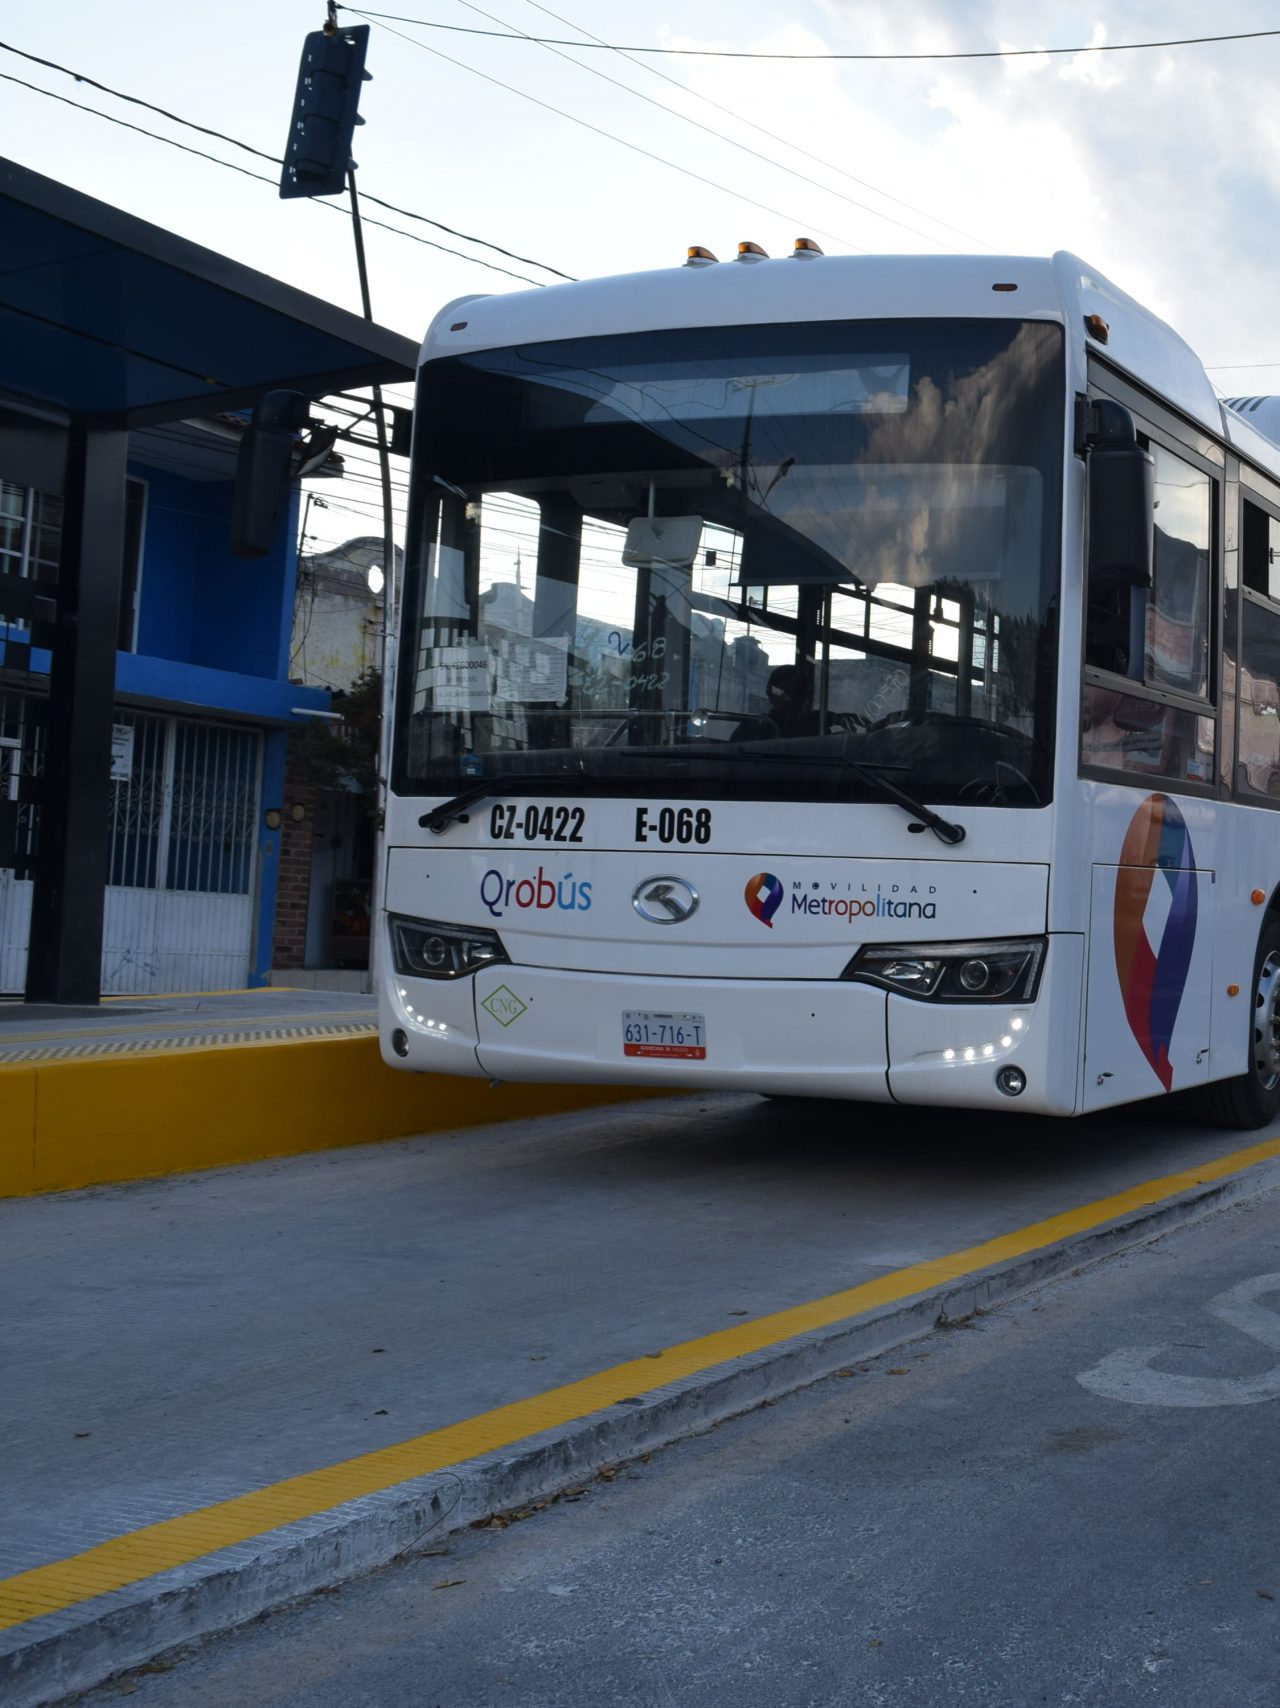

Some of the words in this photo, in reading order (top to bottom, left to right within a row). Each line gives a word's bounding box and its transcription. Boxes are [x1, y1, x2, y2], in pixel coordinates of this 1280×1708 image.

[490, 804, 585, 842] CZ-0422
[635, 807, 711, 844] E-068
[480, 866, 593, 917] Qrobús
[793, 882, 936, 894] MOVILIDAD
[791, 893, 936, 924] Metropolitana
[490, 997, 517, 1014] CNG
[625, 1023, 701, 1046] 631-716-T
